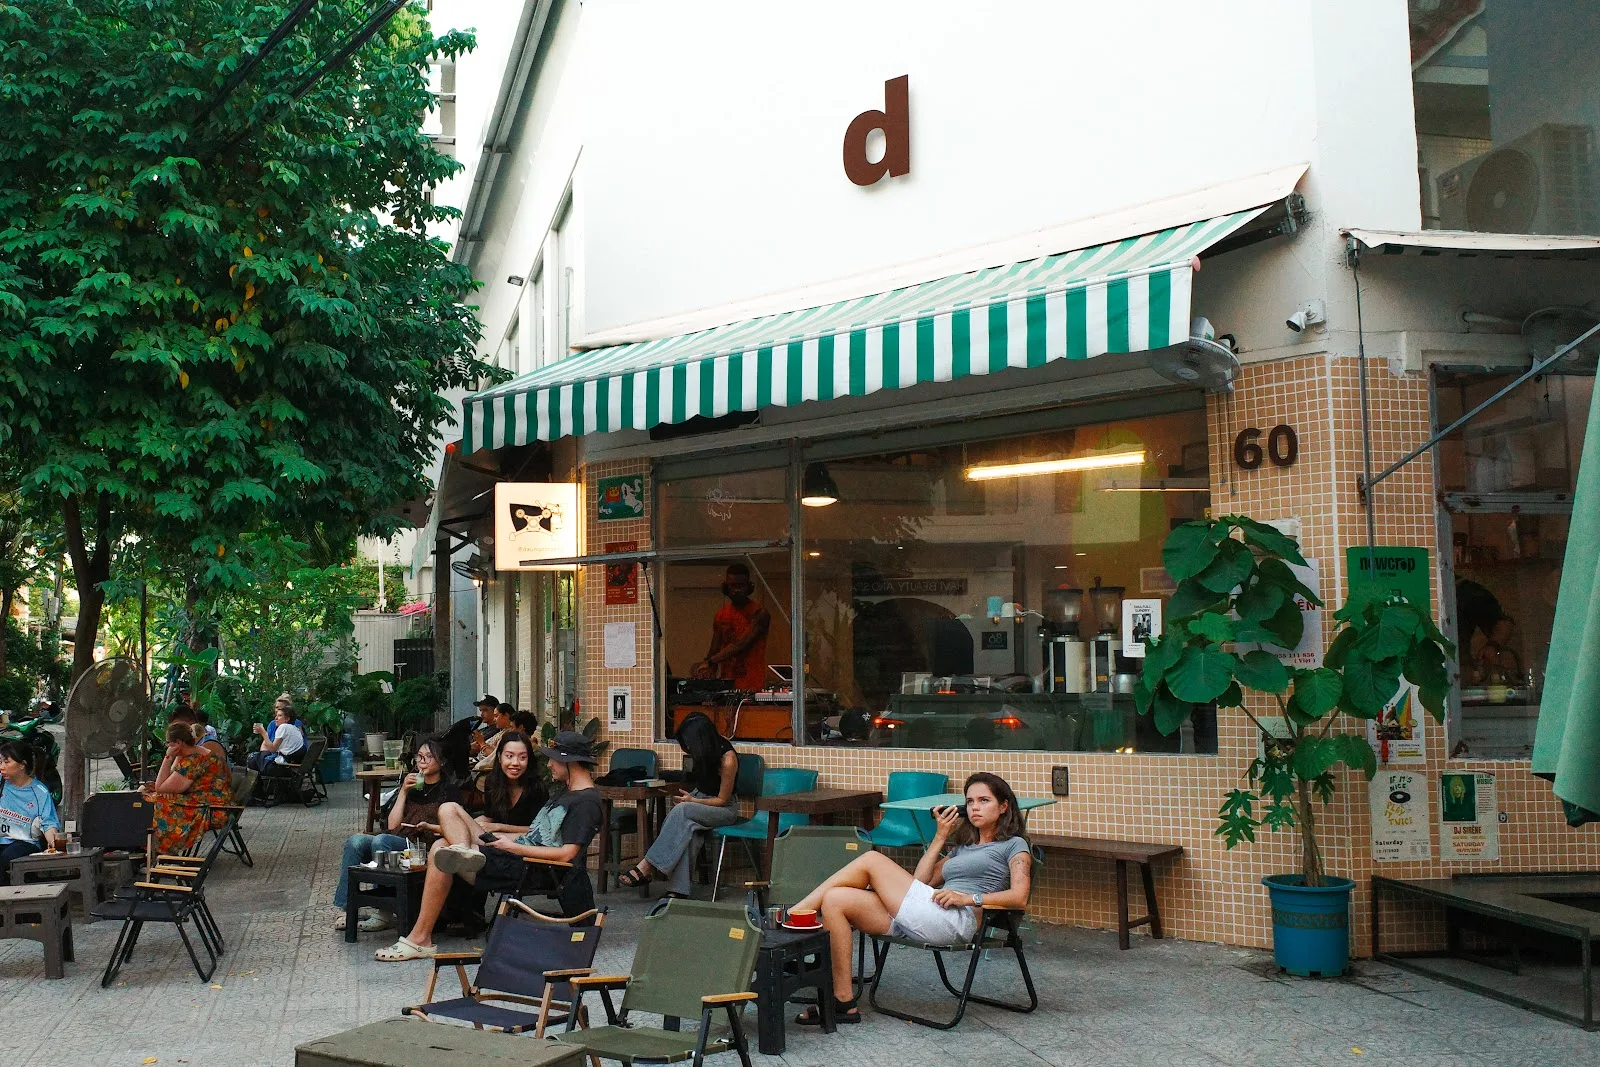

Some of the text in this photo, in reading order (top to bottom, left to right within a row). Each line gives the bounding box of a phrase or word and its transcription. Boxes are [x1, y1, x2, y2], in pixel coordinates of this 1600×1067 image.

[843, 74, 910, 186] d
[1234, 424, 1299, 470] 60
[1389, 776, 1396, 784] IF
[1389, 783, 1407, 792] NICE
[1388, 816, 1413, 826] TWICE
[1453, 826, 1462, 835] DJ
